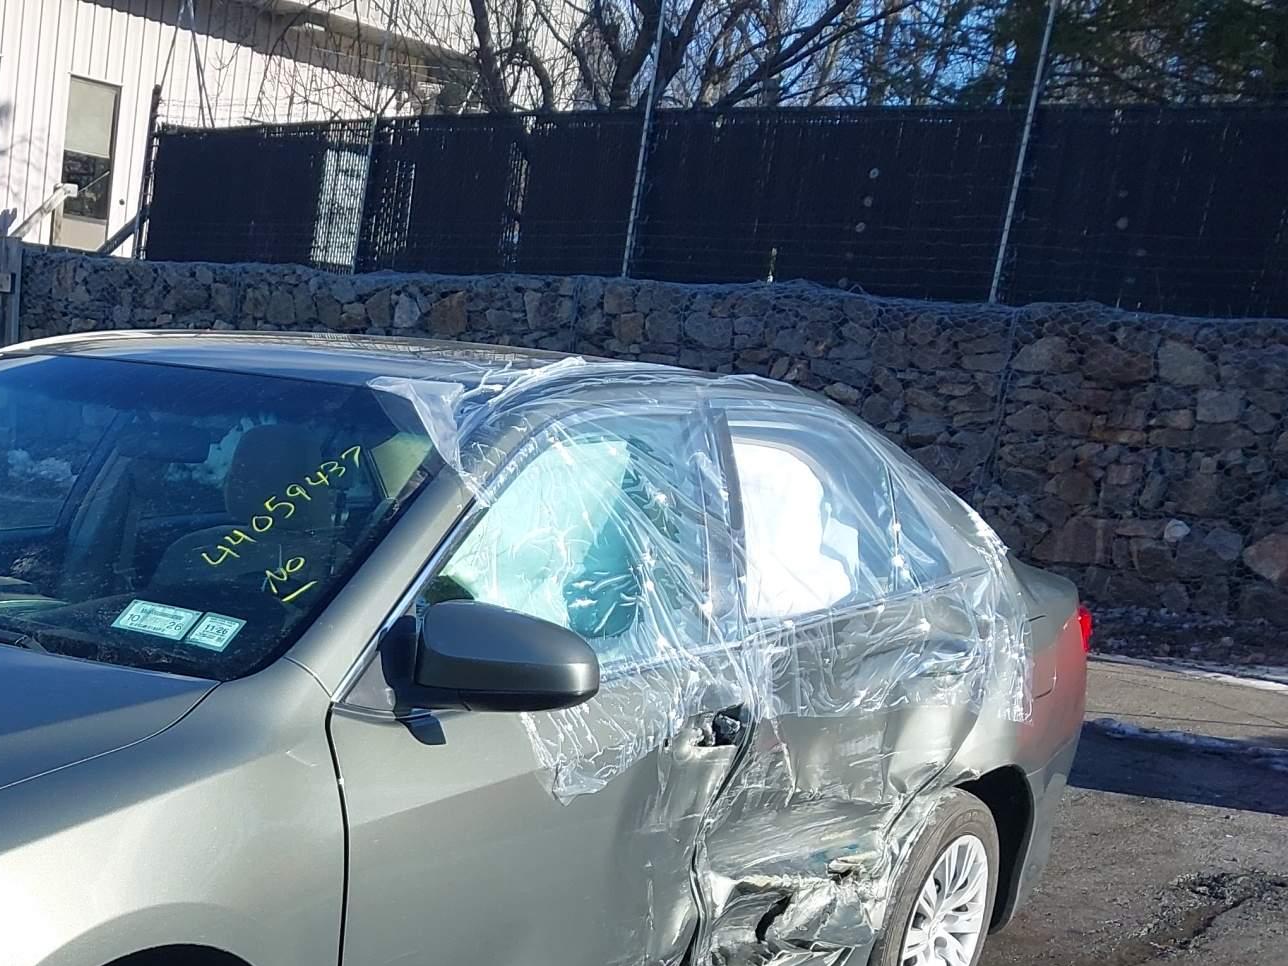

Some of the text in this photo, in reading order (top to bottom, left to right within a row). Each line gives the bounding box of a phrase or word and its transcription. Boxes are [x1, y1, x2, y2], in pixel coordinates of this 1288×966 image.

[202, 445, 361, 565] 44059437
[128, 613, 141, 622] 10
[166, 621, 184, 631] 26
